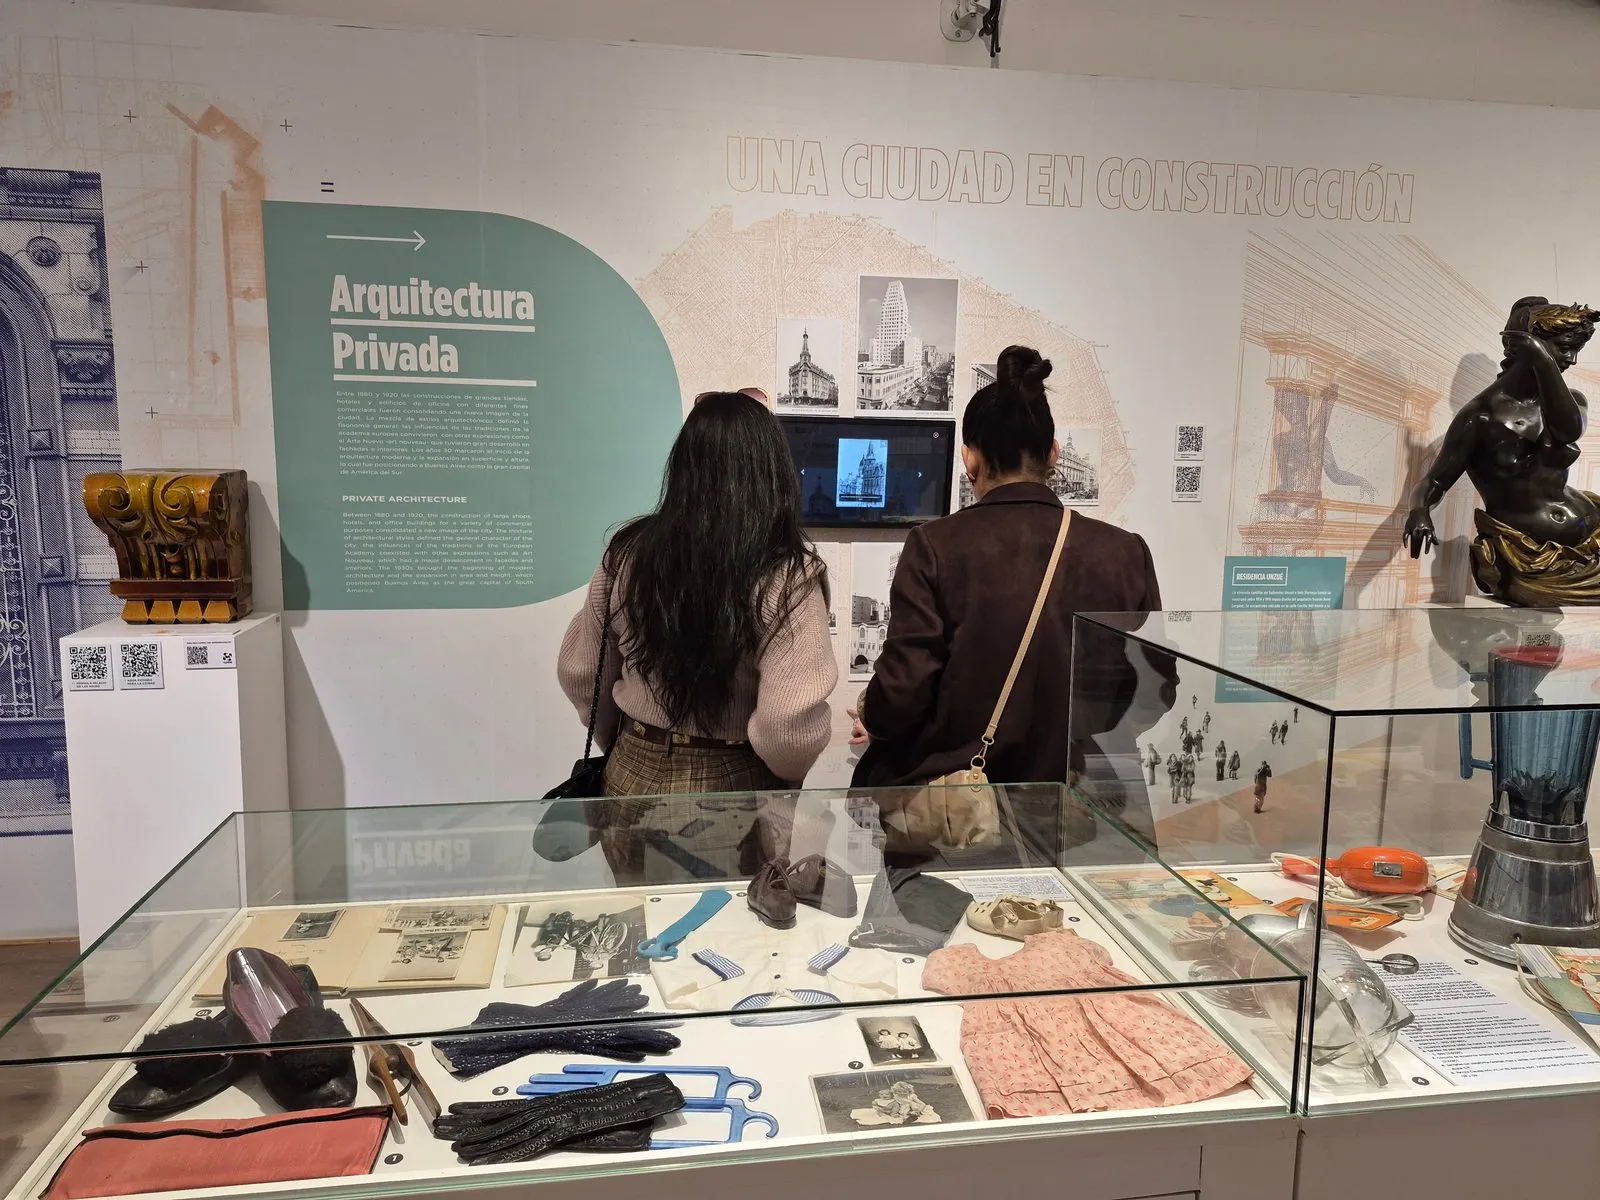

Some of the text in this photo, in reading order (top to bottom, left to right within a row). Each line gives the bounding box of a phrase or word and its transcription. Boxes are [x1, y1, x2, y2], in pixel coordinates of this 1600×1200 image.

[726, 135, 1415, 223] UNA CIUDAD EN CONSTRUCCIÓN
[330, 274, 535, 320] Arquitectura
[332, 332, 459, 373] Privada
[342, 495, 468, 504] PRIVATE ARCHITECTURE
[1236, 573, 1266, 581] RESIDENCIA
